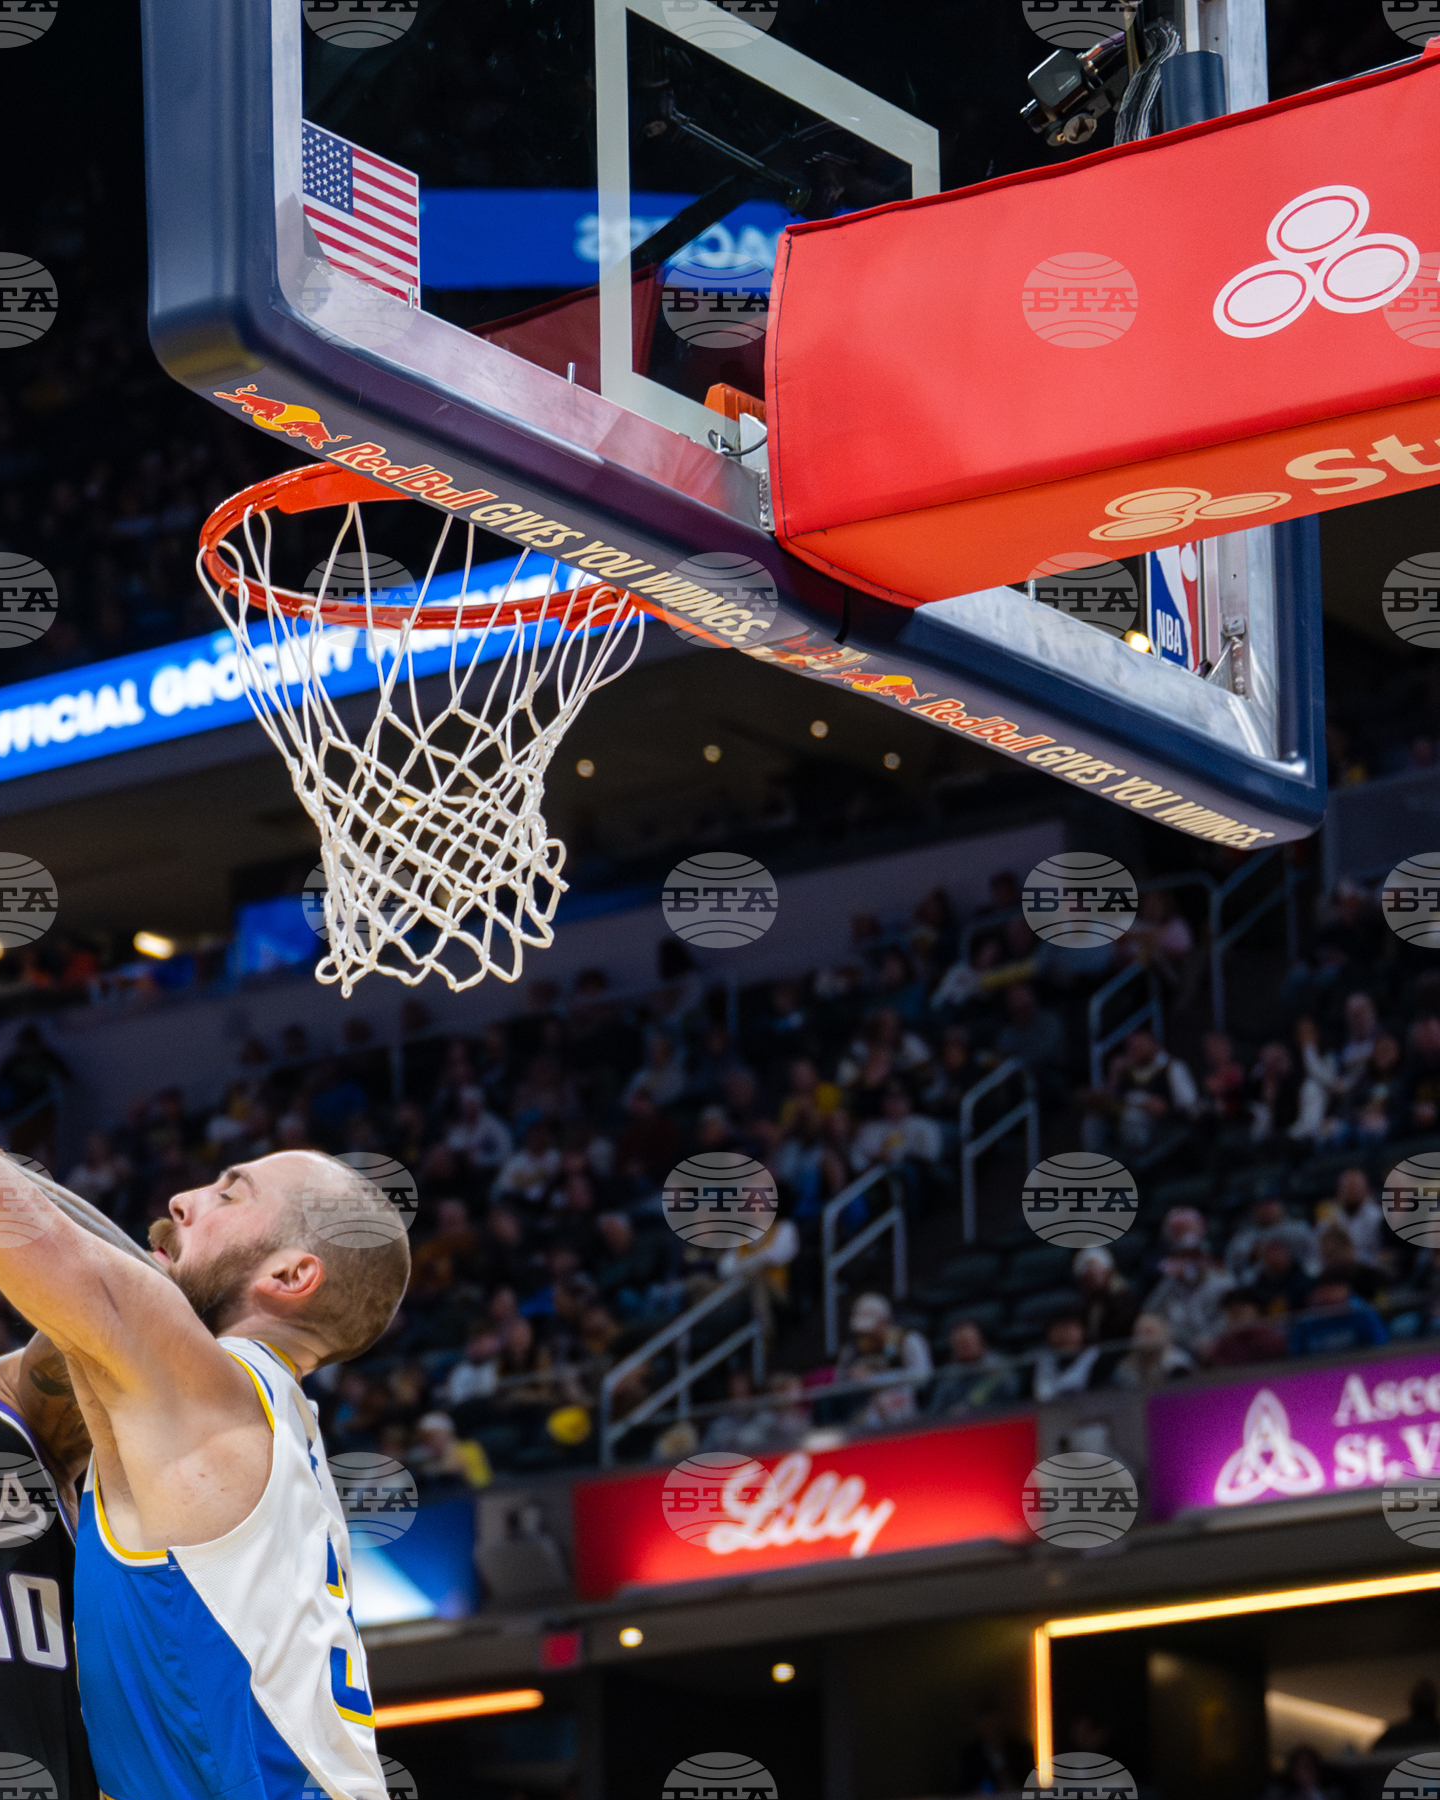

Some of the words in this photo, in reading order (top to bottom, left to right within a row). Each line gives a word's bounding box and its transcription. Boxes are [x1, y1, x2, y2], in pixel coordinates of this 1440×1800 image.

[1285, 434, 1440, 495] St
[469, 502, 585, 549] GIVES
[566, 541, 655, 579] YOU
[1156, 608, 1183, 656] NBA
[1026, 746, 1126, 784] GIVES
[1100, 776, 1182, 809] YOU
[706, 1451, 896, 1559] Lilly
